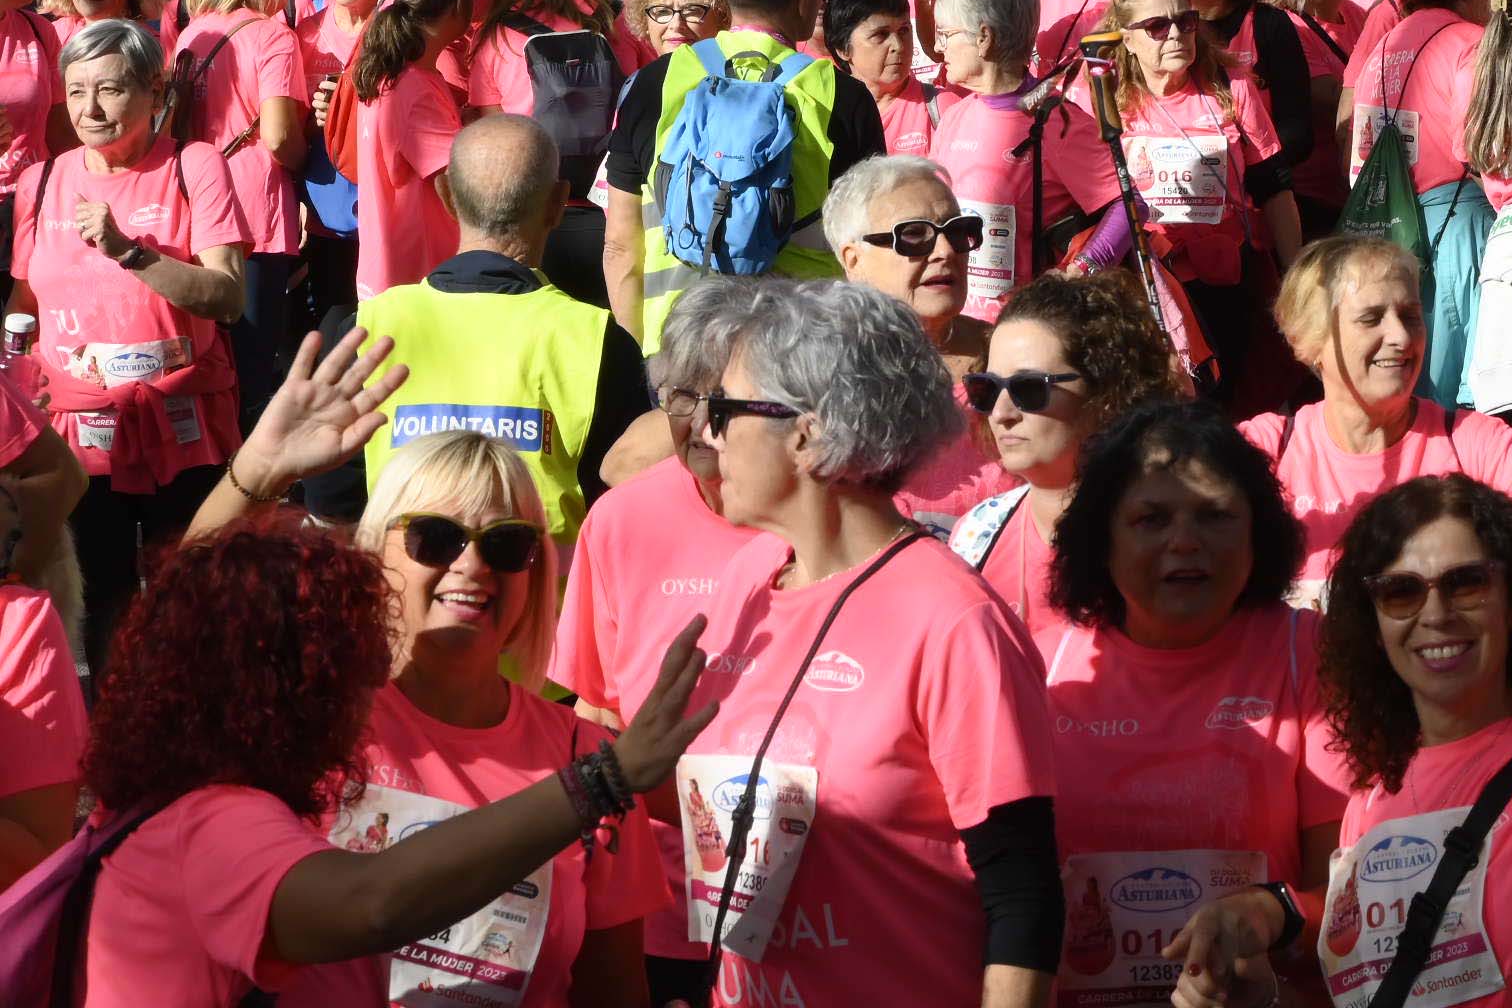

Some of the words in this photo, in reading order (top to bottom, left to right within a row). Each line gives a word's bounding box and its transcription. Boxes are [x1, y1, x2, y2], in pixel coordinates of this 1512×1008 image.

[392, 415, 539, 441] VOLUNTARIS
[661, 577, 719, 595] OYSH
[1363, 852, 1432, 876] ASTURIANA
[1119, 886, 1195, 903] ASTURIANA
[410, 946, 428, 962] LA
[429, 951, 474, 973] MUJER
[1426, 967, 1483, 995] Santander
